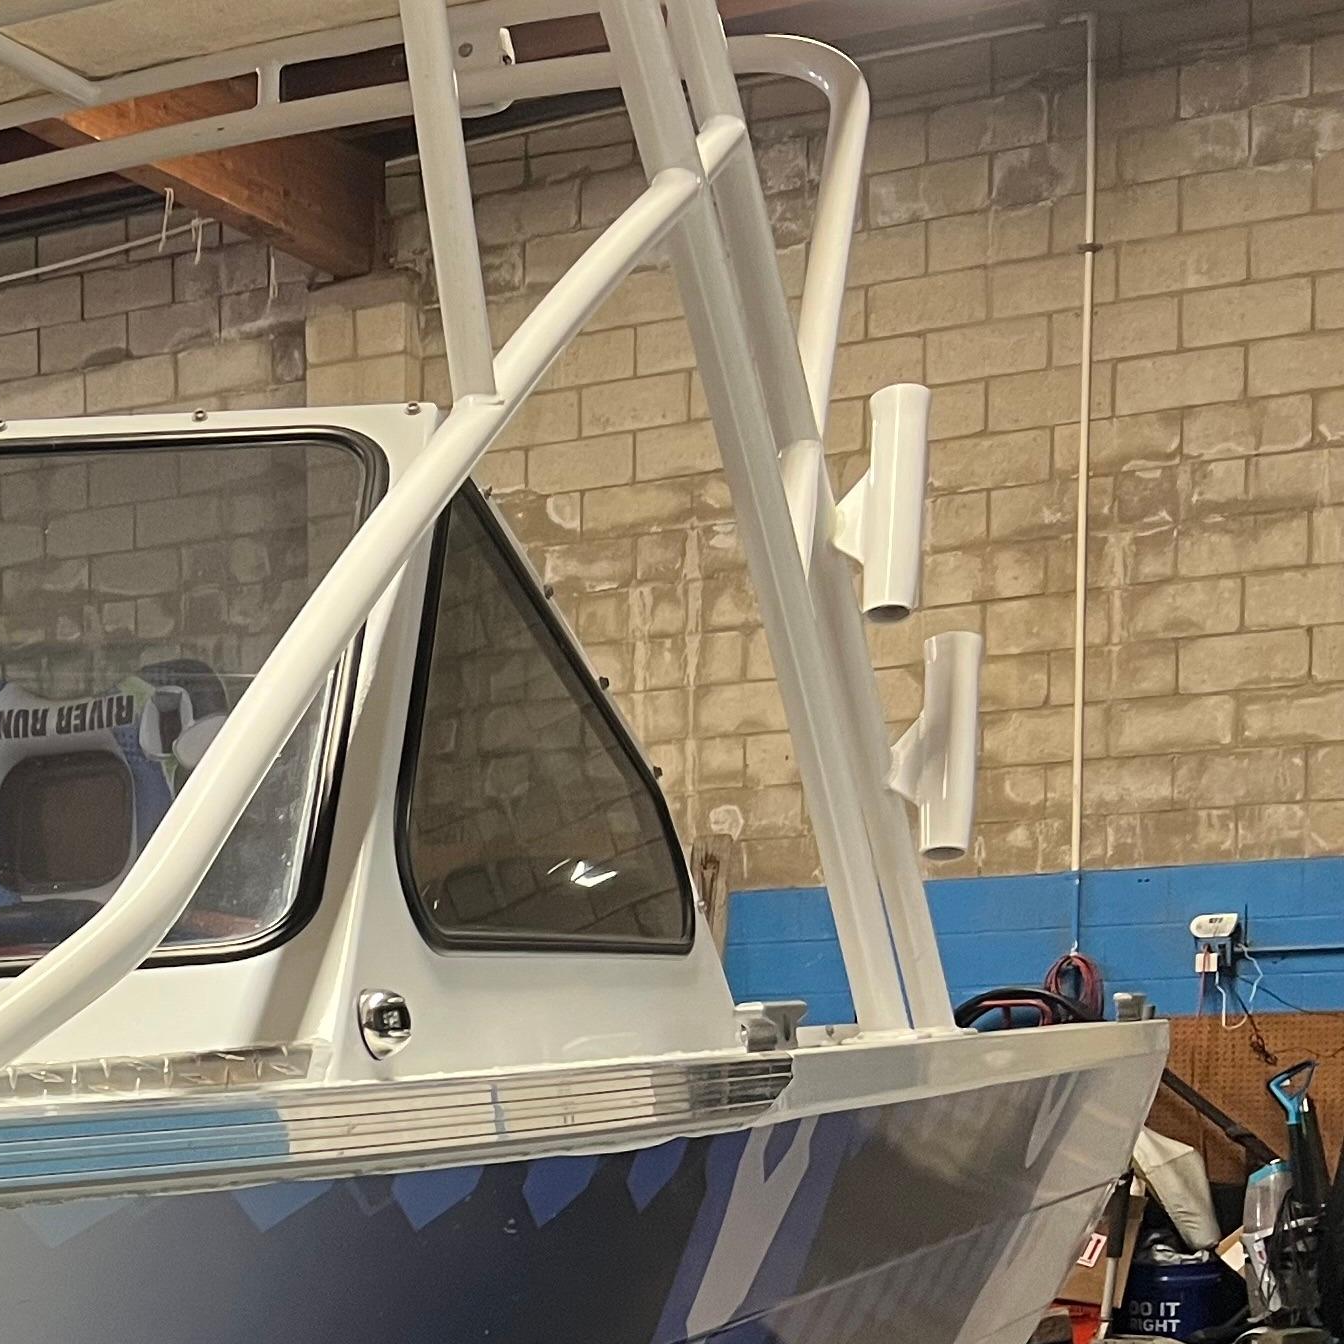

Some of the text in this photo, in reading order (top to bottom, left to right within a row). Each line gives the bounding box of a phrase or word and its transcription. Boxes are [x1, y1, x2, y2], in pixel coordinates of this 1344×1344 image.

[55, 694, 135, 735] RIVER
[1129, 1301, 1181, 1317] DO IT
[1128, 1318, 1181, 1333] RIGHT
